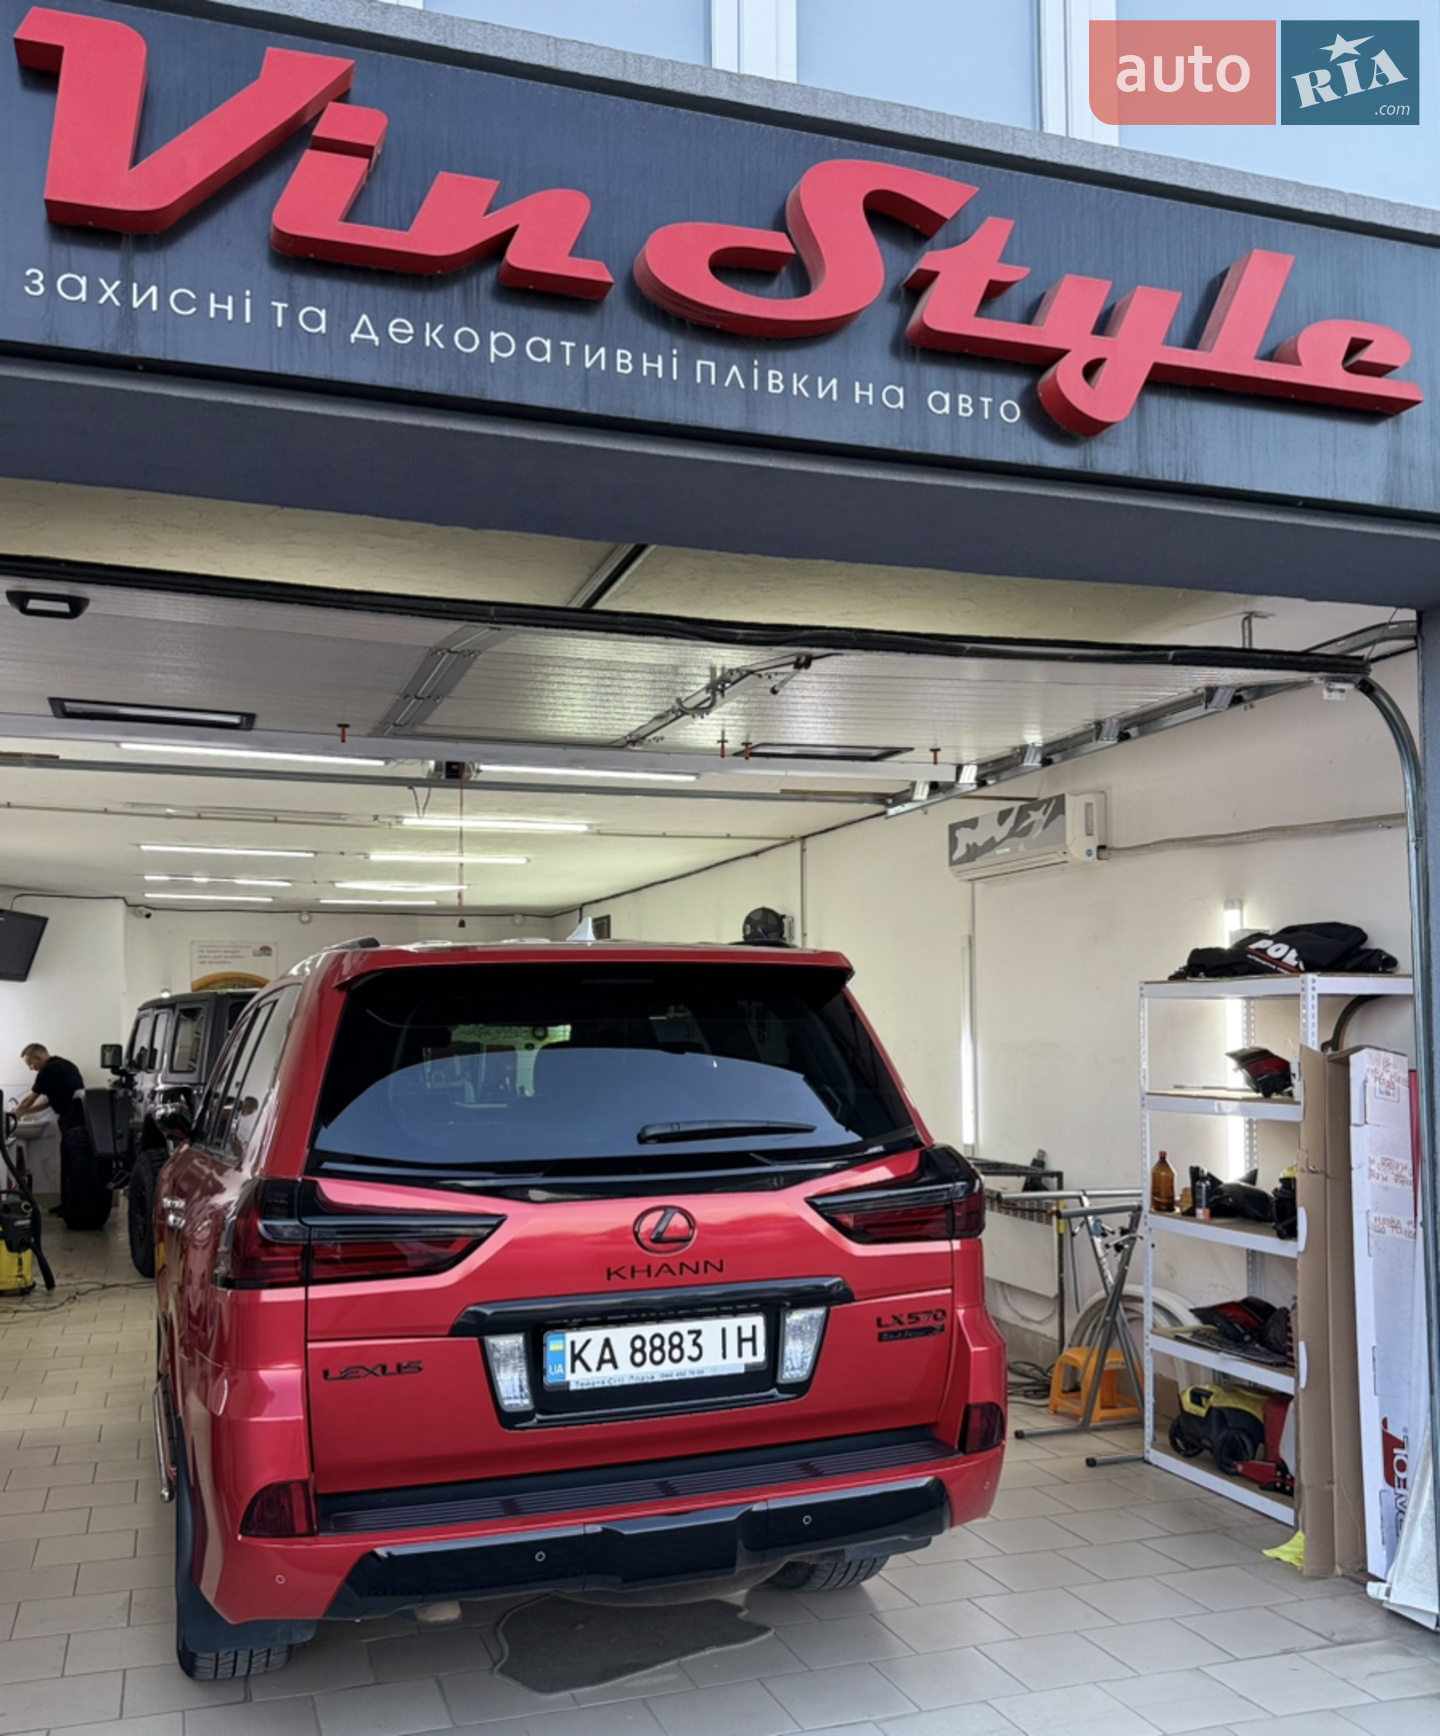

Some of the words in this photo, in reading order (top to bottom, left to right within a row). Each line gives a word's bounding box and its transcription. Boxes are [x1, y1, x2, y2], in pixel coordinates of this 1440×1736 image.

[24, 268, 251, 324] захисні
[271, 301, 327, 334] та
[350, 314, 677, 380] декоративні
[696, 359, 838, 402] плівки
[854, 380, 904, 409] на
[928, 390, 1021, 424] авто
[606, 1259, 724, 1281] KHANN
[570, 1336, 619, 1374] KA
[629, 1329, 704, 1369] 8883
[720, 1323, 758, 1360] IH
[322, 1359, 424, 1381] LEXUS
[549, 1363, 565, 1376] UA
